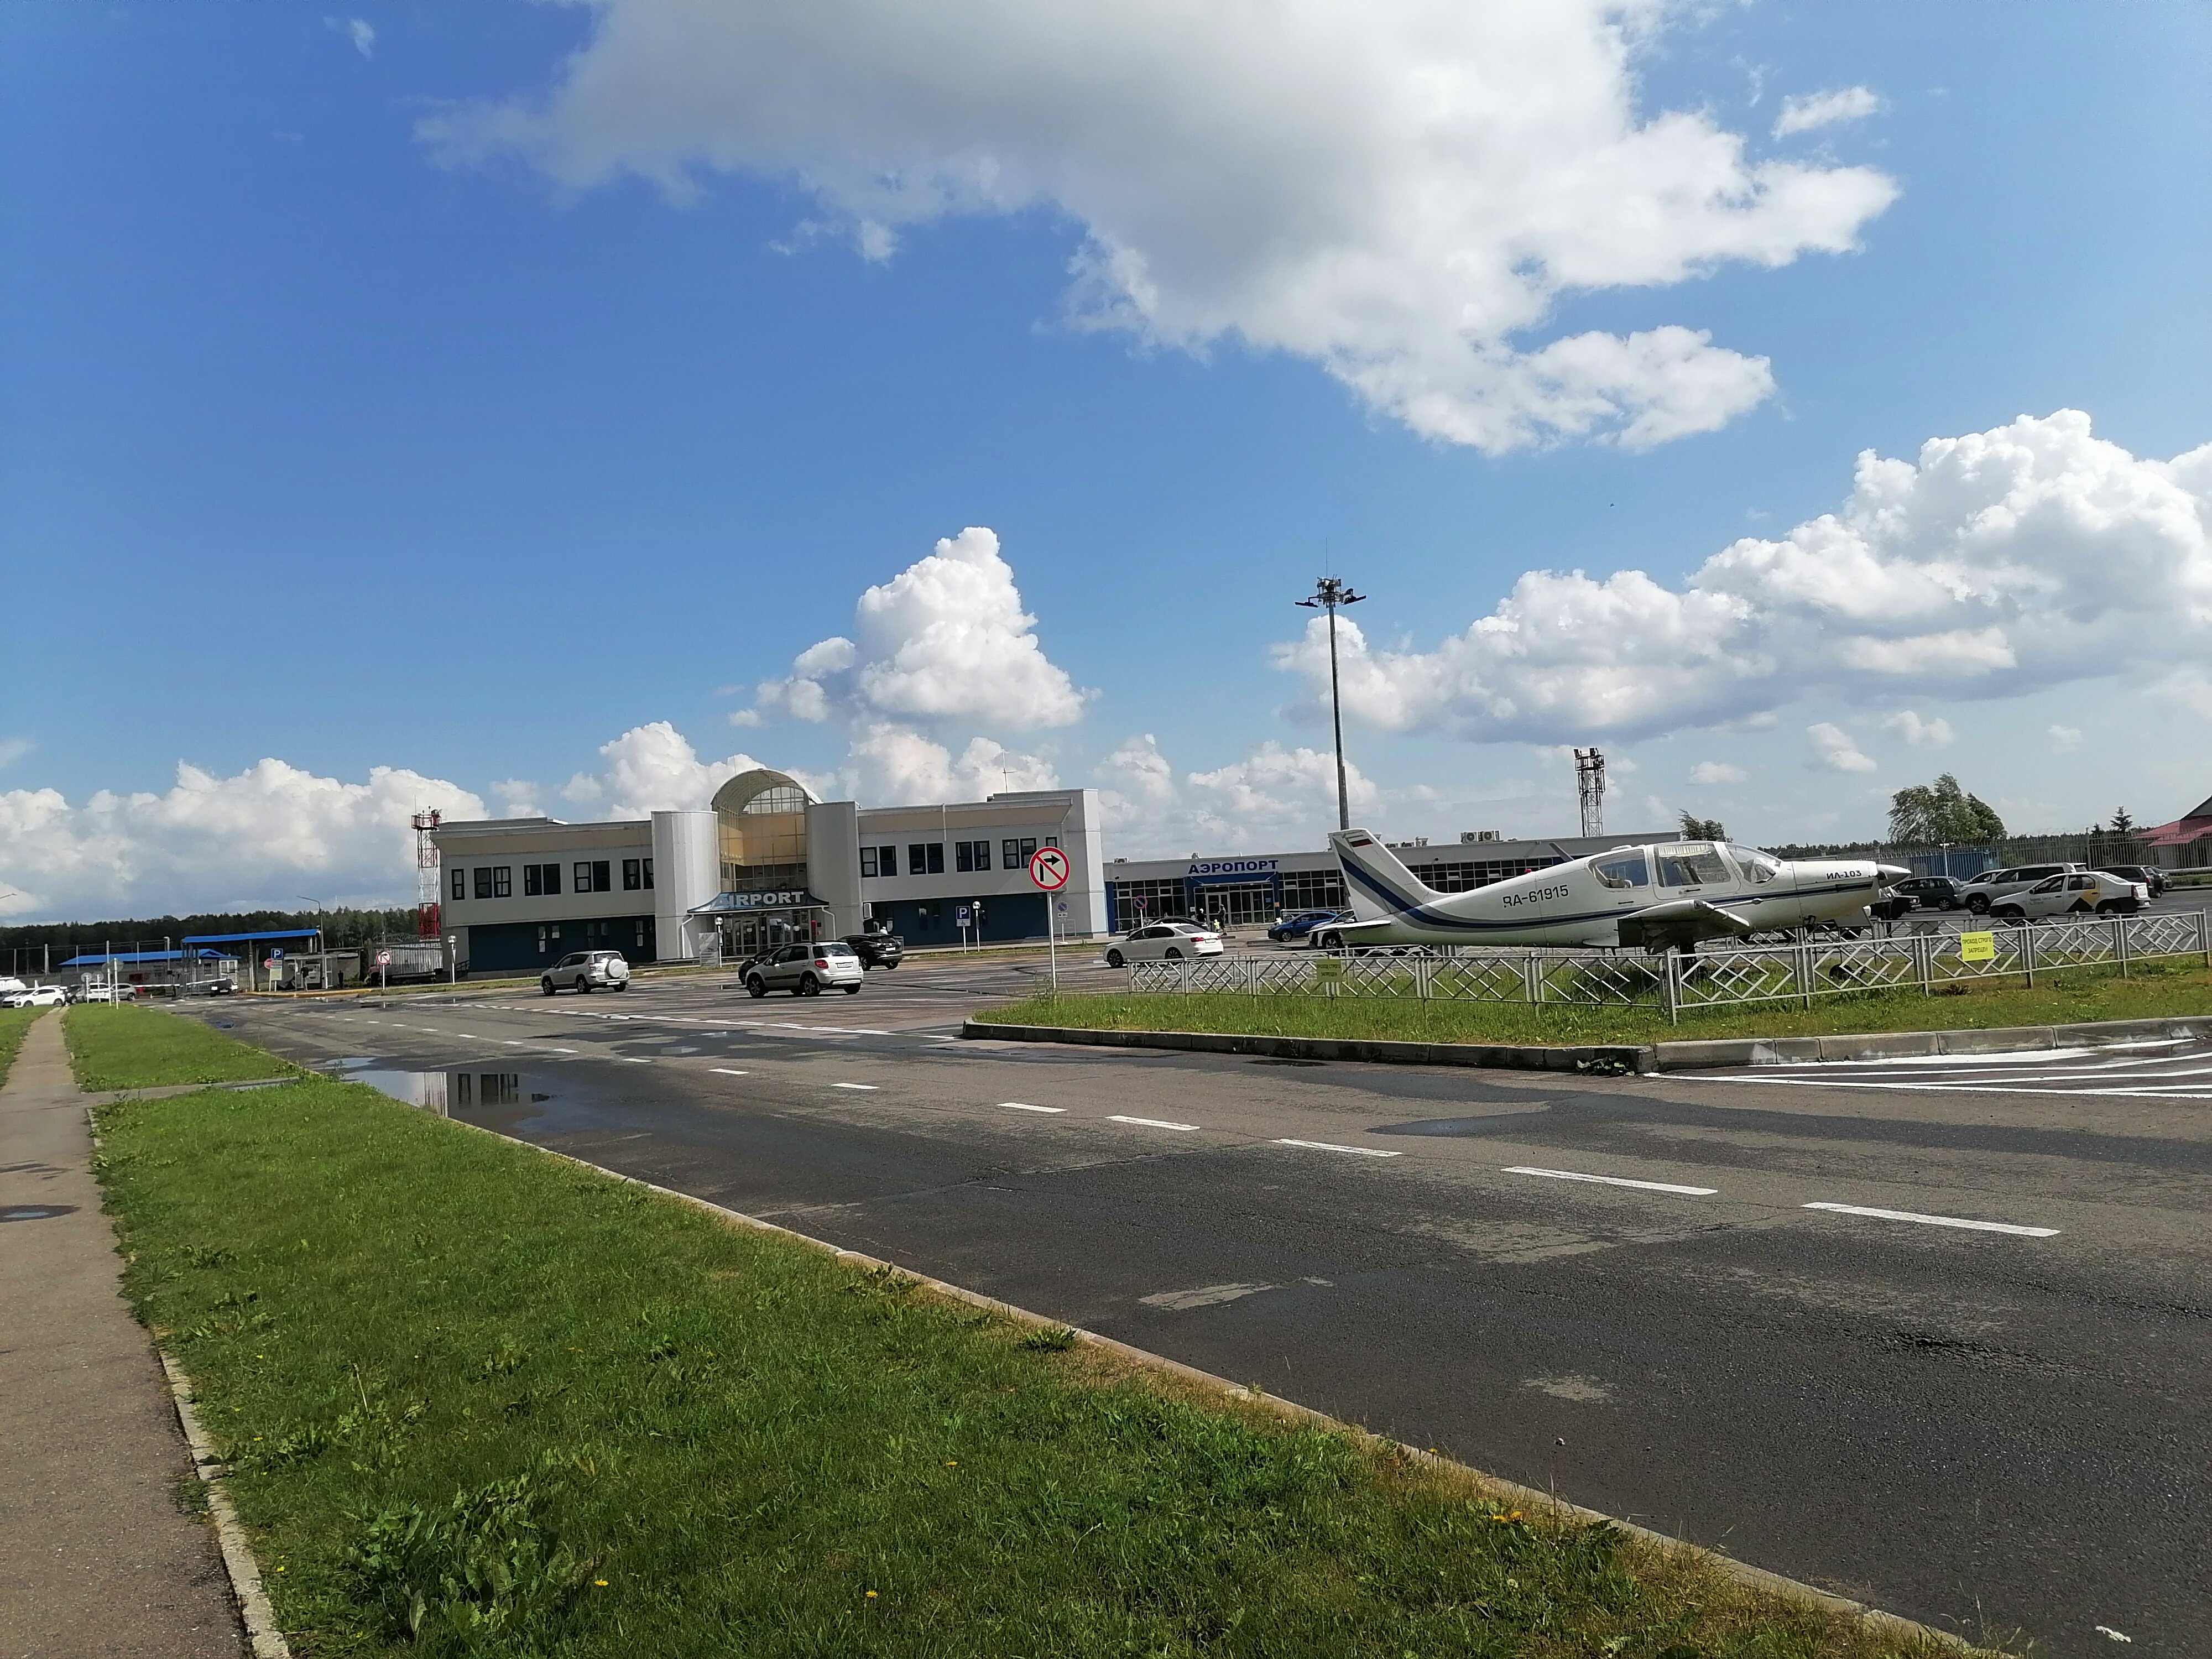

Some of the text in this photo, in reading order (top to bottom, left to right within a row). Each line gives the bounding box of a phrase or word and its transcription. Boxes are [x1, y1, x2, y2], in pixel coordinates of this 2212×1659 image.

[1188, 860, 1279, 874] АЭРОПОРТ
[1826, 870, 1862, 880] ИЛ-103
[713, 891, 804, 908] AIRPORT
[1503, 884, 1569, 908] RA-61915
[959, 907, 967, 918] P
[274, 950, 280, 958] P
